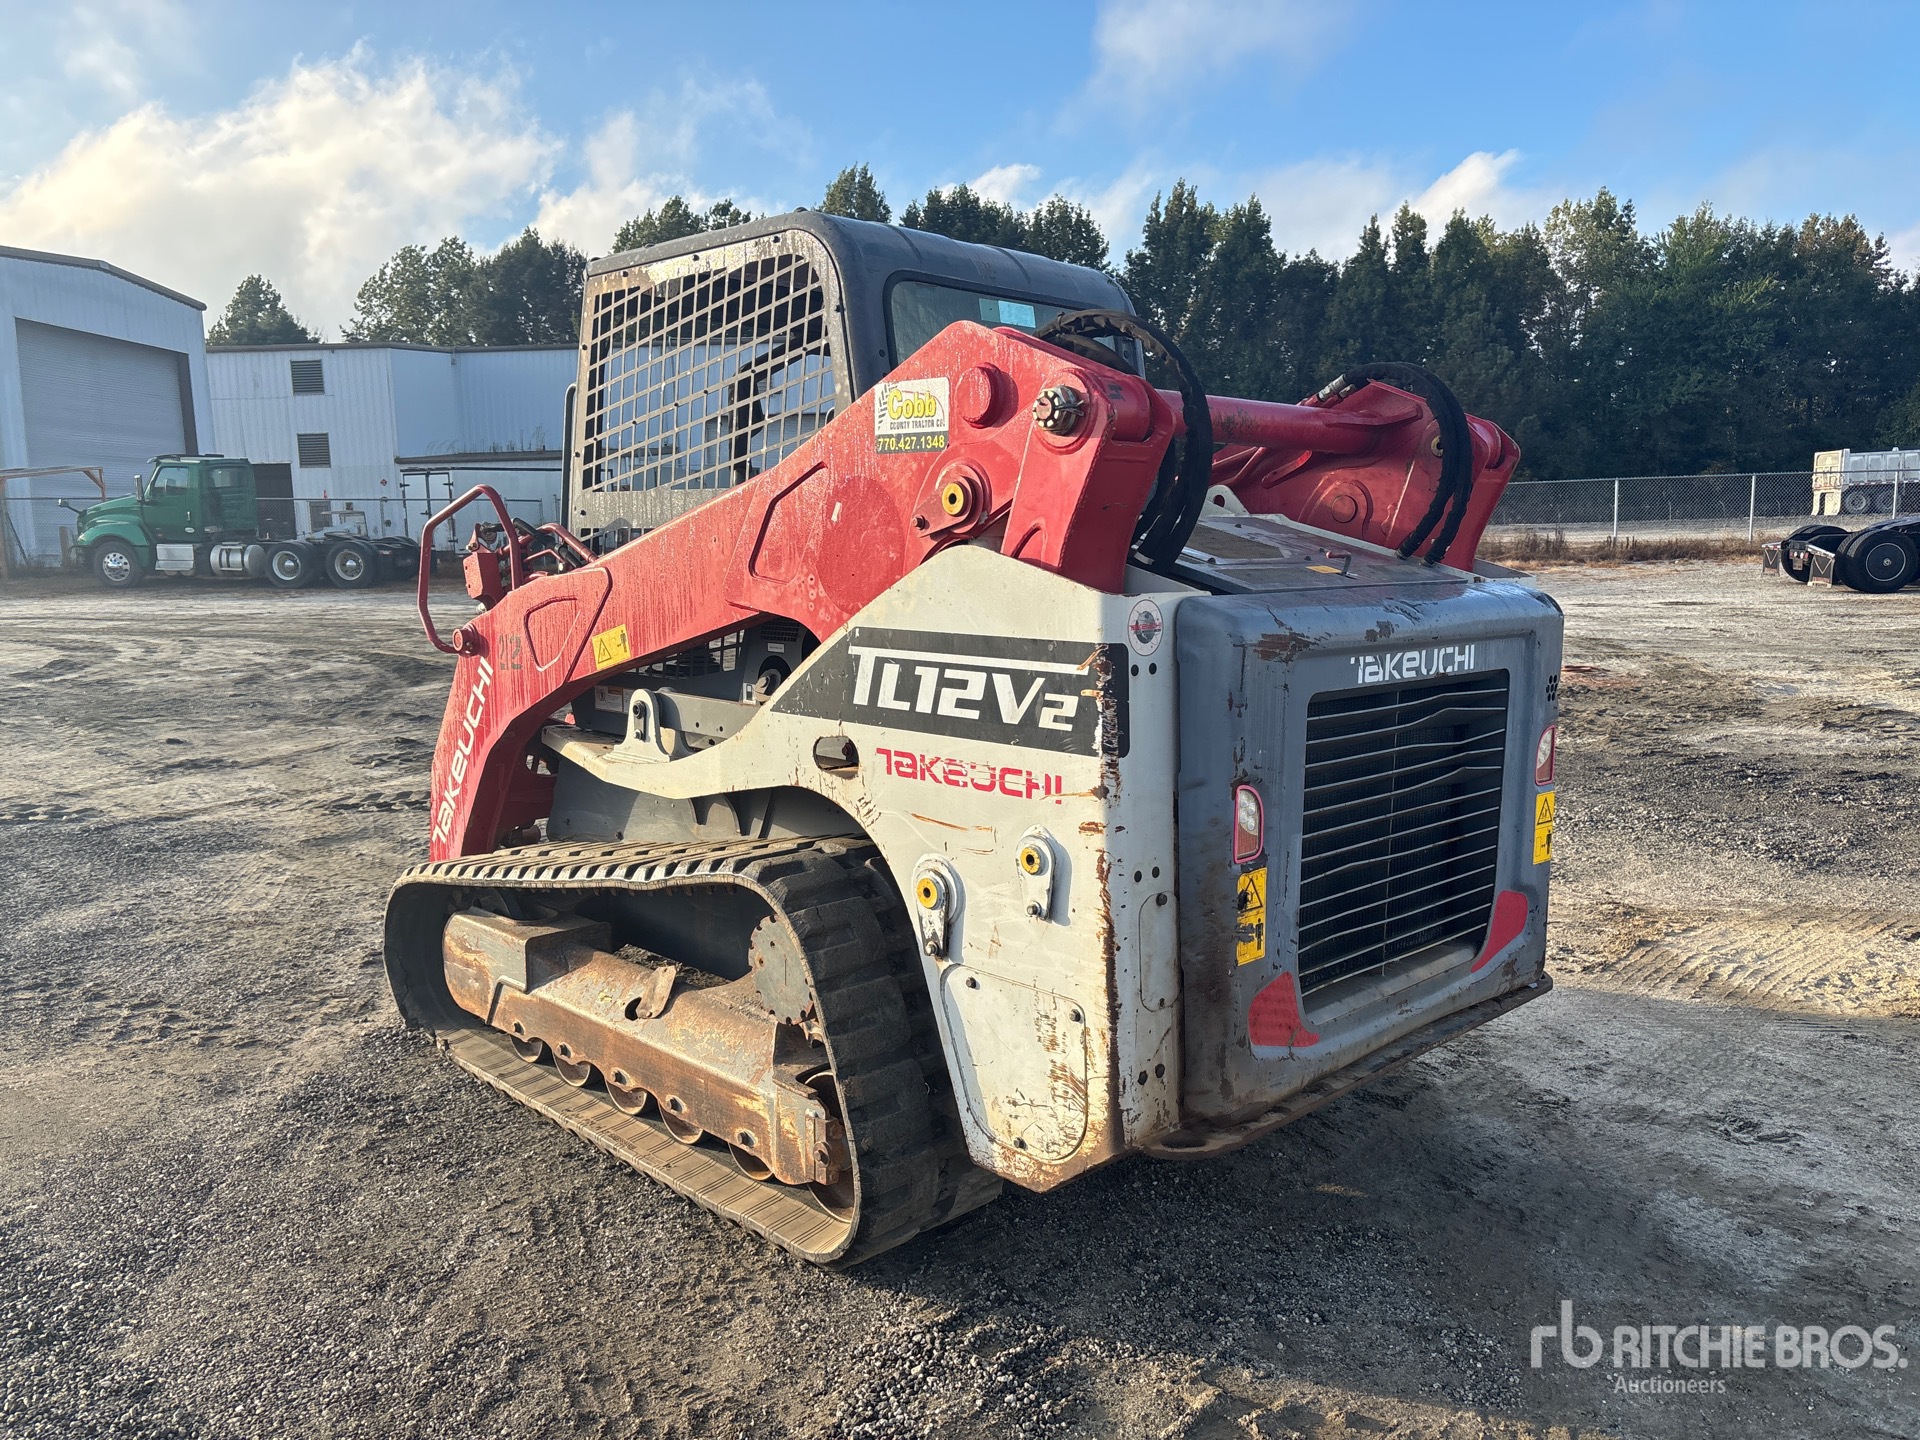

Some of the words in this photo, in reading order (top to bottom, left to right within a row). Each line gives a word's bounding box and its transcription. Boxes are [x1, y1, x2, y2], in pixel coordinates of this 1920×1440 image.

[888, 389, 937, 420] Cobb
[890, 421, 911, 430] COUNTY
[912, 419, 935, 429] TRACTOR
[878, 435, 945, 452] 770.427.1348
[848, 645, 1089, 732] TL12V2
